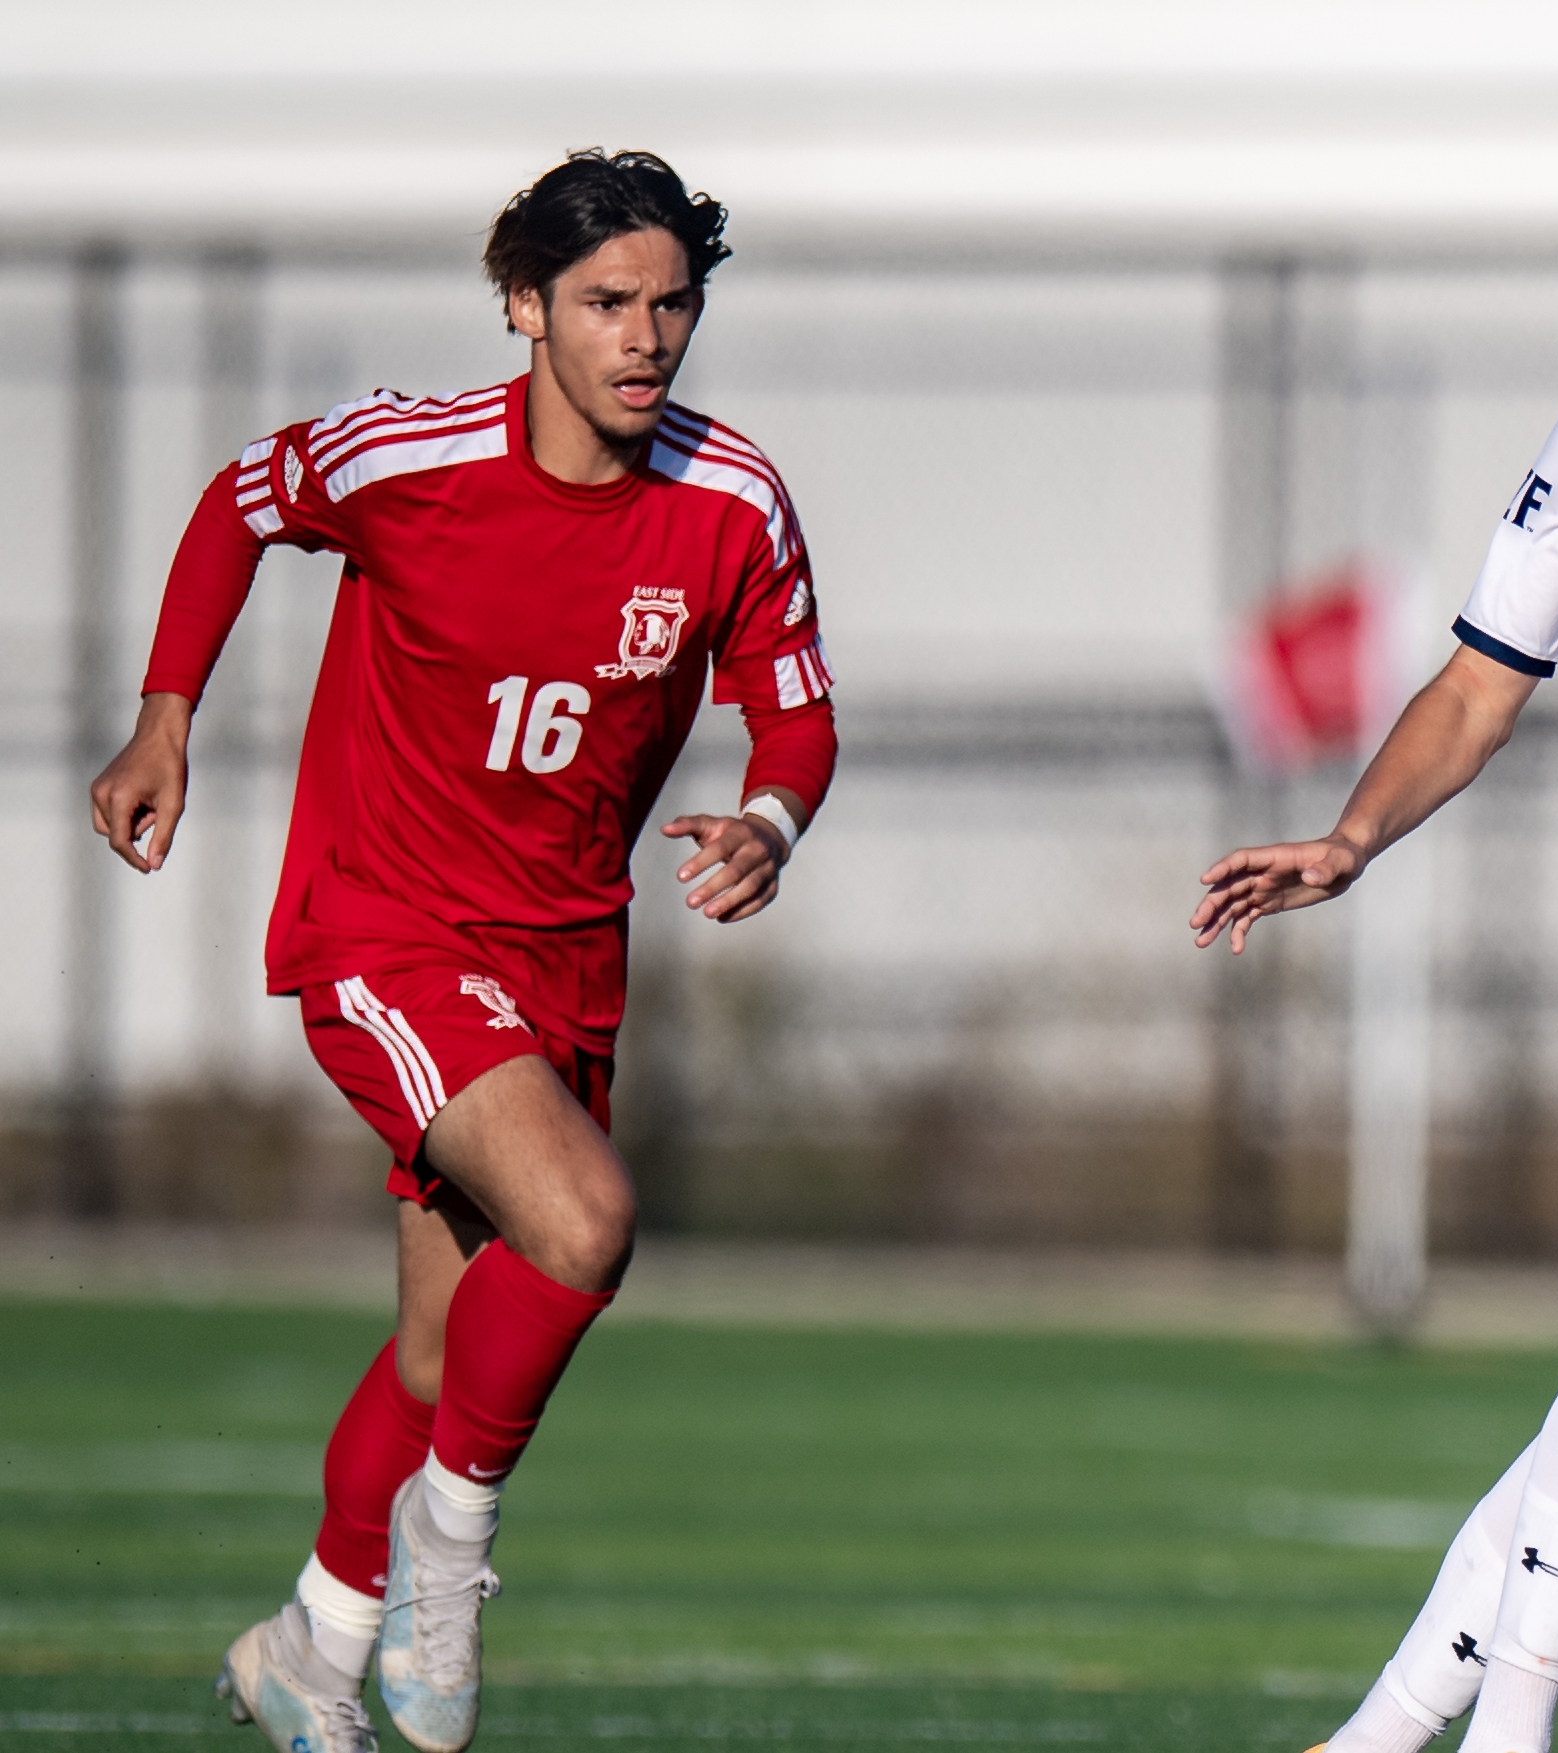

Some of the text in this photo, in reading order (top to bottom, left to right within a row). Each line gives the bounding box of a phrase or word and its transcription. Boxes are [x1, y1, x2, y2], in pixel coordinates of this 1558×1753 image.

[1503, 468, 1553, 529] F
[633, 585, 659, 599] EAST
[485, 675, 591, 774] 16
